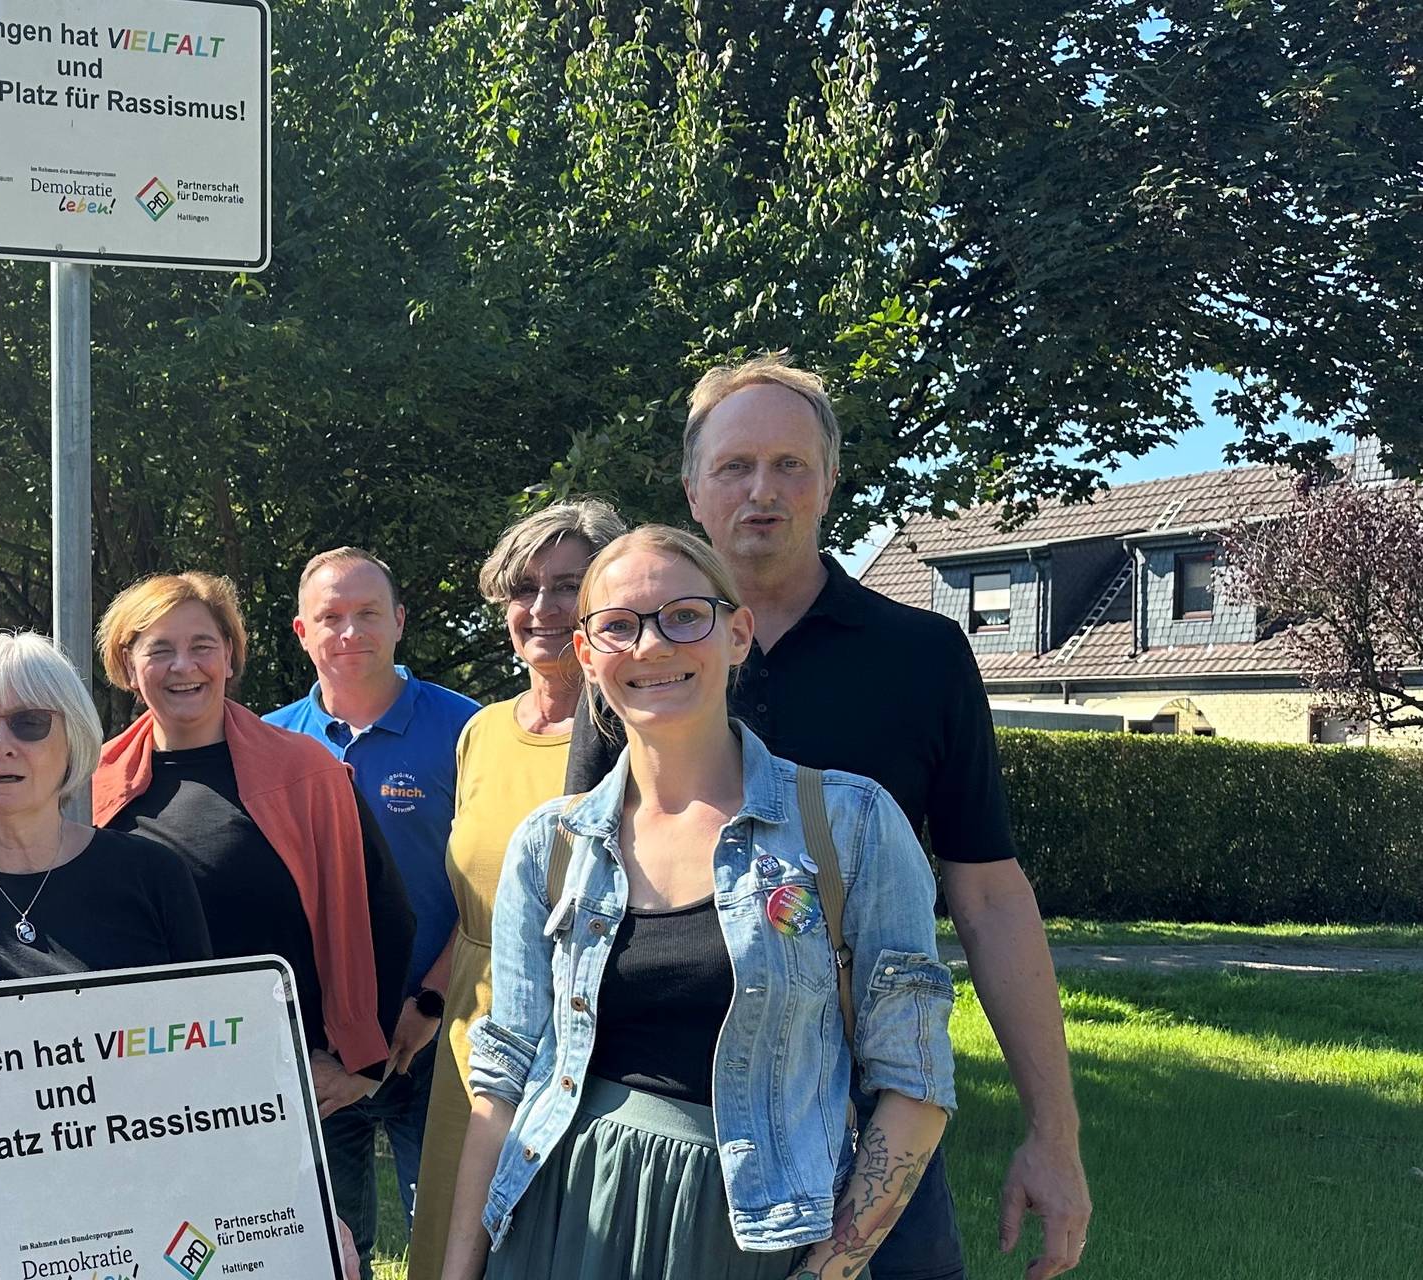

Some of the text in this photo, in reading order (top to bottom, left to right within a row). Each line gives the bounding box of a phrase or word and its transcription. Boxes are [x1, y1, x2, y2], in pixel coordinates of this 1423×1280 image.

[60, 23, 99, 48] hat
[107, 27, 225, 58] VIELFALT
[57, 58, 103, 79] und
[64, 86, 100, 110] für
[107, 90, 246, 122] Rassismus!
[30, 177, 113, 198] Demokratie
[177, 180, 240, 193] Partnerschaft
[177, 191, 245, 204] für Demokratie
[147, 191, 170, 216] PfD
[177, 212, 210, 223] Hattingen
[389, 772, 416, 782] ORIGINAL
[380, 784, 426, 798] Bench.
[387, 803, 416, 813] CLOTHING
[757, 857, 775, 868] FCK
[762, 863, 779, 874] AFD
[33, 1037, 85, 1068] hat
[94, 1016, 244, 1061] VIELFALT
[35, 1076, 97, 1111] und
[51, 1121, 98, 1152] für
[106, 1093, 287, 1145] Rassismus!
[214, 1207, 296, 1230] Partnerschaft
[19, 1227, 134, 1252] im Rahmen des Bundesprogramms
[217, 1222, 305, 1246] für Demokratie
[22, 1245, 134, 1280] Demokratie
[179, 1238, 208, 1275] PfD
[221, 1260, 264, 1275] Hattingen
